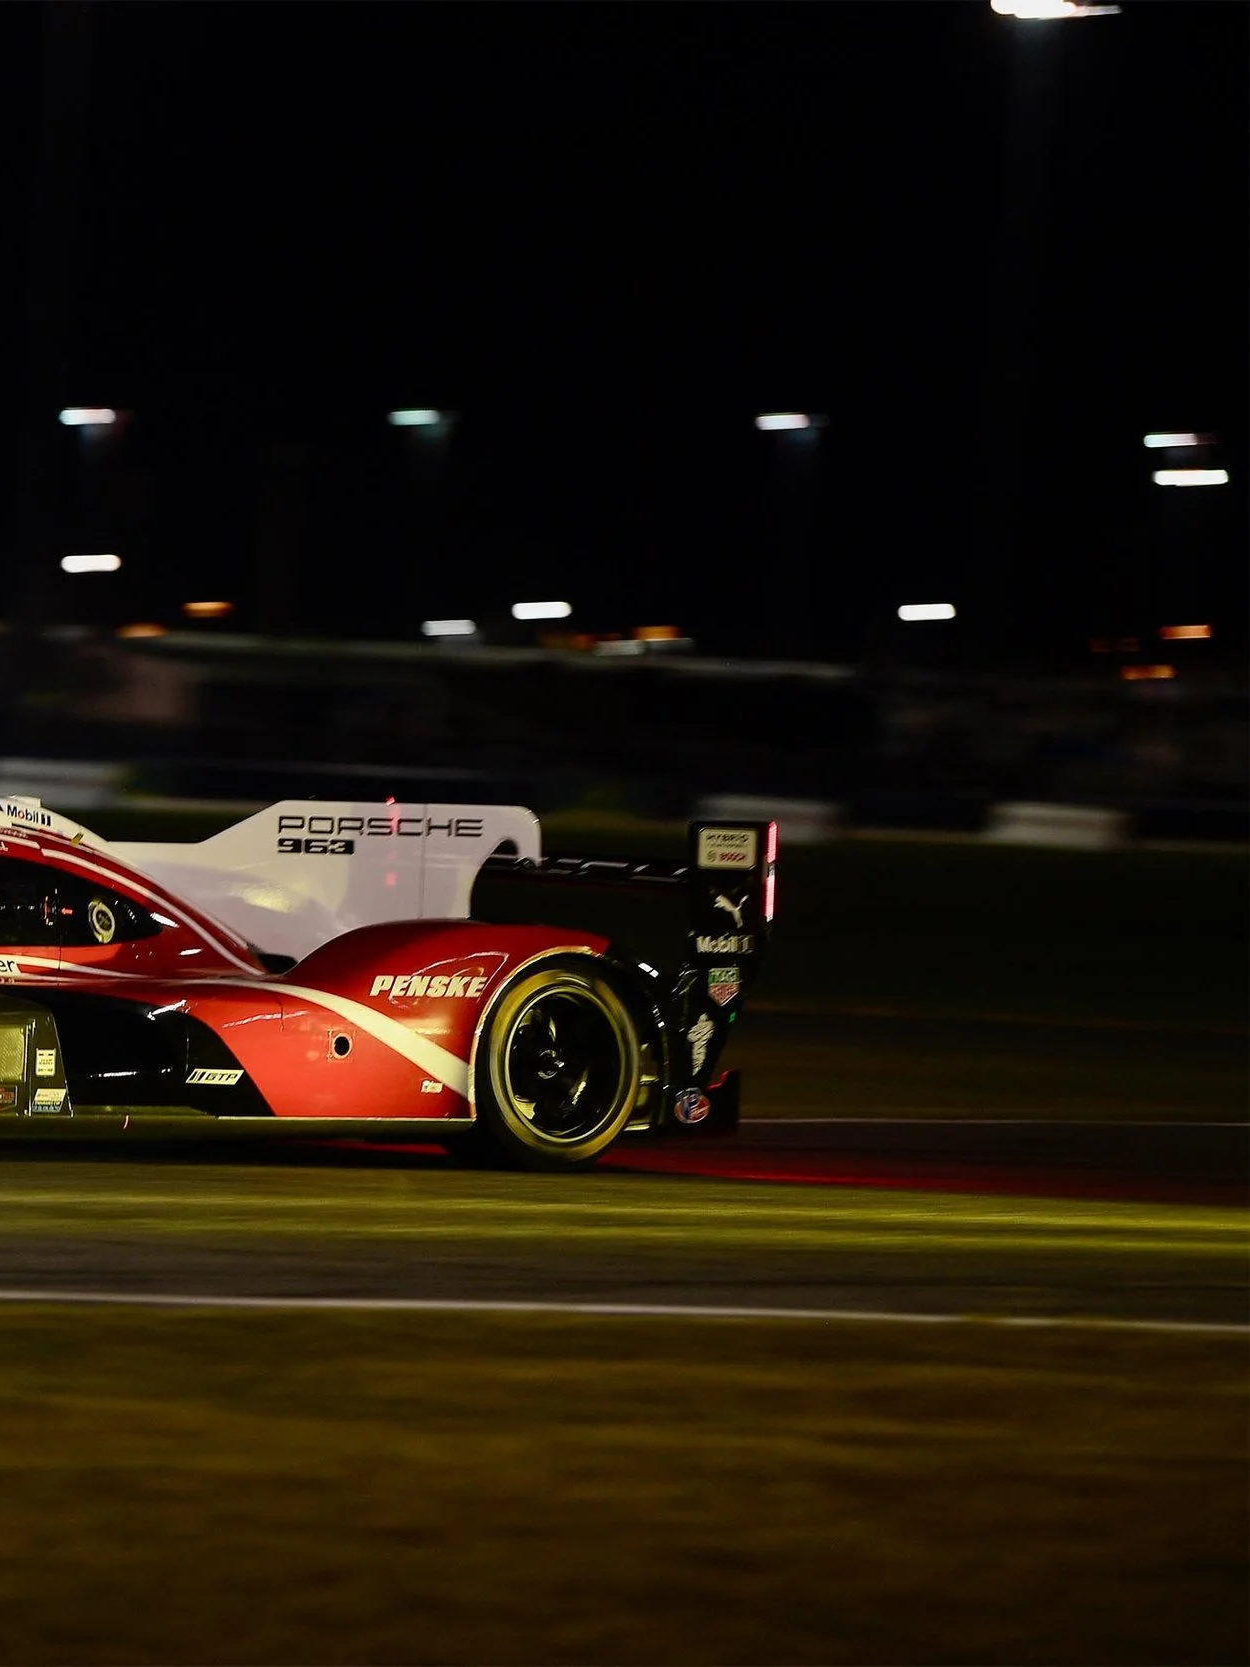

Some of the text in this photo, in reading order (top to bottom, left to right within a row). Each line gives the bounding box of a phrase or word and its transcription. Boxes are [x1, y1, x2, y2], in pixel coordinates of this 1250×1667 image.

[7, 804, 39, 823] Mobil
[278, 816, 484, 837] PORSCHE
[277, 838, 355, 855] 963
[369, 975, 488, 998] PENSKE
